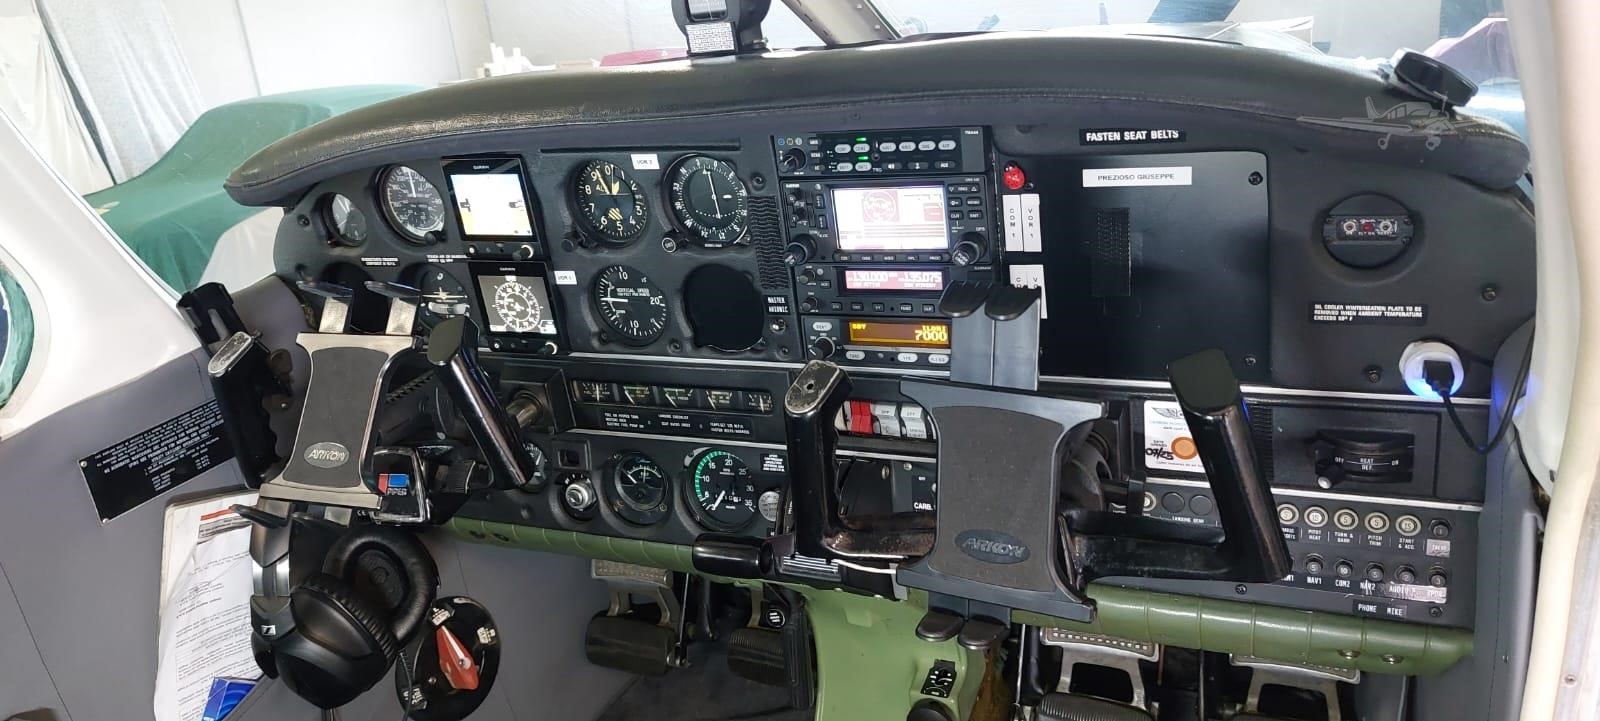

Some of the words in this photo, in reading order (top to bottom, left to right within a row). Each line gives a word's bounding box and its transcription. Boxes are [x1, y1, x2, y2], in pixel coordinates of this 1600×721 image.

[1086, 131, 1120, 142] FASTEN
[1123, 130, 1147, 141] SEAT
[1151, 129, 1179, 140] BELTS
[605, 165, 611, 175] 0
[621, 170, 625, 180] 1
[679, 166, 688, 175] N
[590, 171, 598, 181] 9
[1097, 174, 1135, 182] PREZIOSO
[1137, 173, 1175, 181] GIUSEPPE
[585, 184, 592, 195] 8
[588, 203, 595, 213] 7
[635, 205, 643, 216] 3
[601, 215, 608, 225] 6
[629, 215, 636, 225] 4
[684, 218, 693, 229] W
[616, 221, 623, 231] 5
[733, 224, 740, 232] S
[619, 271, 628, 280] 10
[650, 296, 660, 305] 20
[767, 296, 785, 304] MASTER
[630, 320, 639, 328] 10
[914, 330, 948, 342] 7000
[308, 449, 346, 462] ARKON
[708, 462, 716, 470] 15
[703, 475, 710, 483] 10
[387, 487, 407, 496] PIPER
[745, 499, 753, 507] 35
[1343, 516, 1348, 524] 5
[1374, 519, 1379, 527] 5
[1372, 571, 1378, 579] 5
[1307, 576, 1322, 584] NAV1
[1335, 579, 1351, 588] COM2
[1360, 581, 1376, 591] NAV2
[1358, 603, 1377, 613] PHONE
[1386, 607, 1403, 616] MIKE
